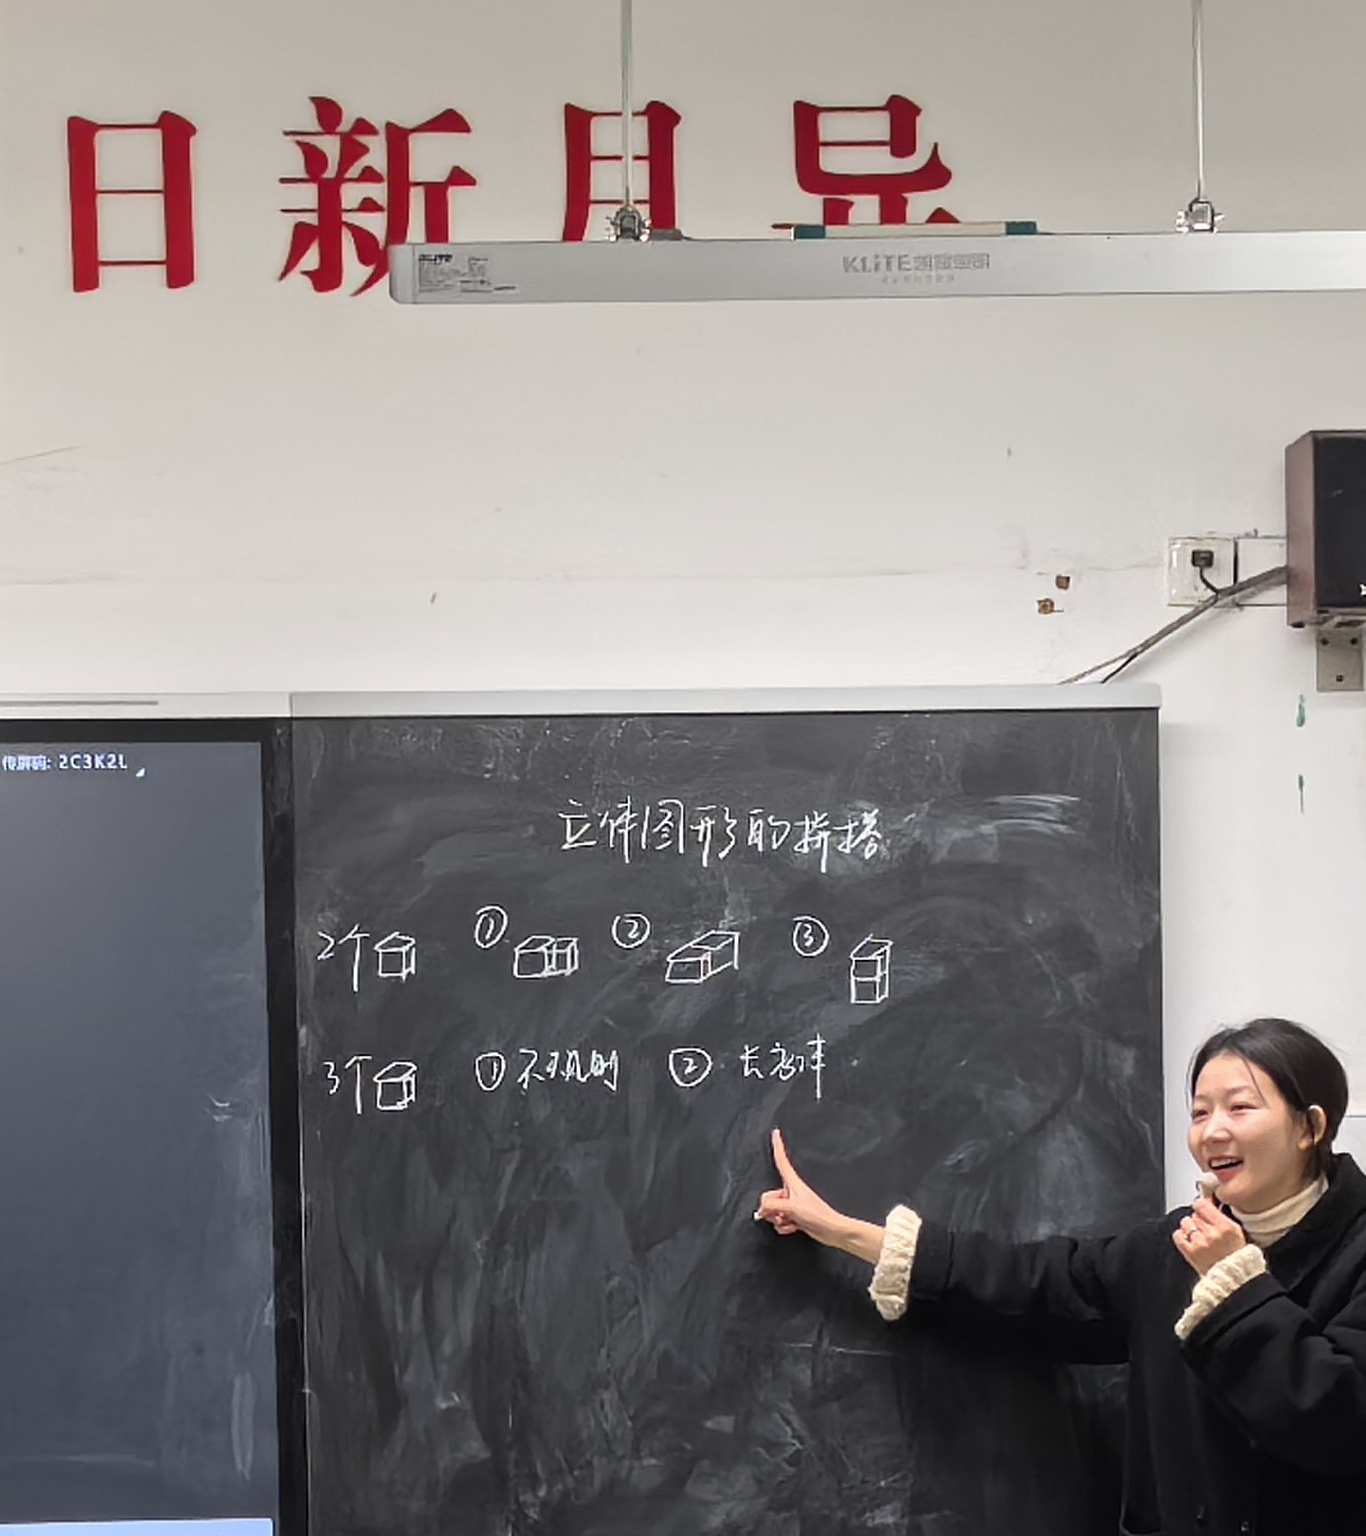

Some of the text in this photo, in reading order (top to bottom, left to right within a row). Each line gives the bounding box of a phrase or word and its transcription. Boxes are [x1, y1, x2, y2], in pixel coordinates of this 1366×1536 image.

[59, 752, 128, 770] 2C3K2L
[558, 796, 883, 874] 立体图形的拼搭
